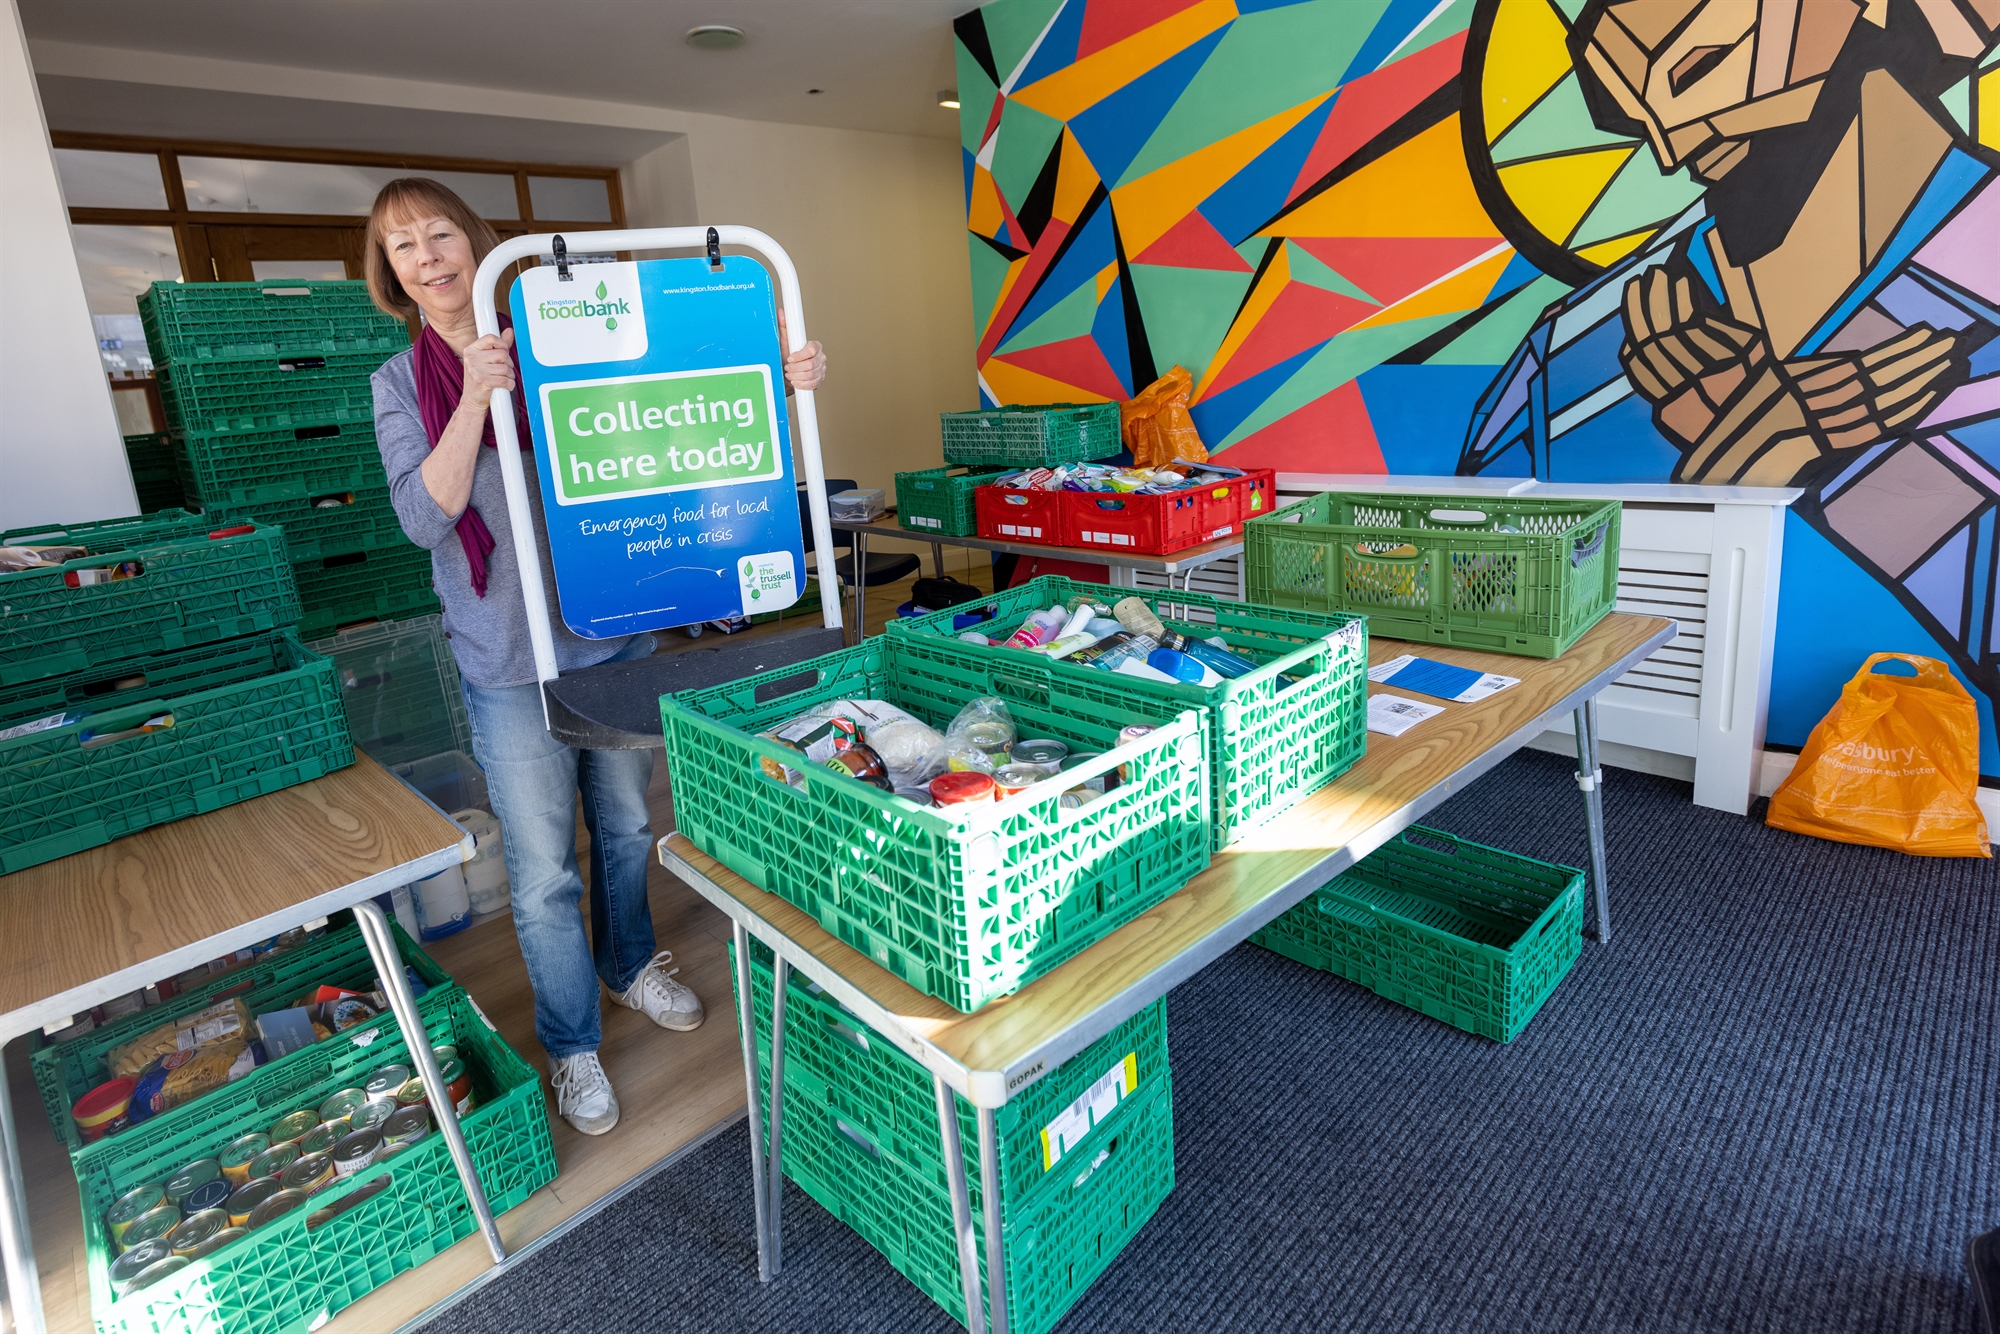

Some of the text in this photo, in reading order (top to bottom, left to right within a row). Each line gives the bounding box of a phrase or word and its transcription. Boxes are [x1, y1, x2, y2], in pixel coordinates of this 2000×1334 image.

[663, 282, 755, 294] www.kingston.foodbank.org.uk
[538, 297, 631, 320] foodbank
[568, 394, 755, 437] Collecting
[569, 437, 765, 485] here today
[579, 496, 770, 536] Emergency food for local
[626, 528, 733, 559] people in crisis
[759, 567, 774, 575] the
[760, 571, 792, 583] trussell
[761, 581, 782, 590] trust
[1885, 769, 1902, 778] eat
[1903, 767, 1936, 776] better
[1009, 1061, 1044, 1090] GOPAK
